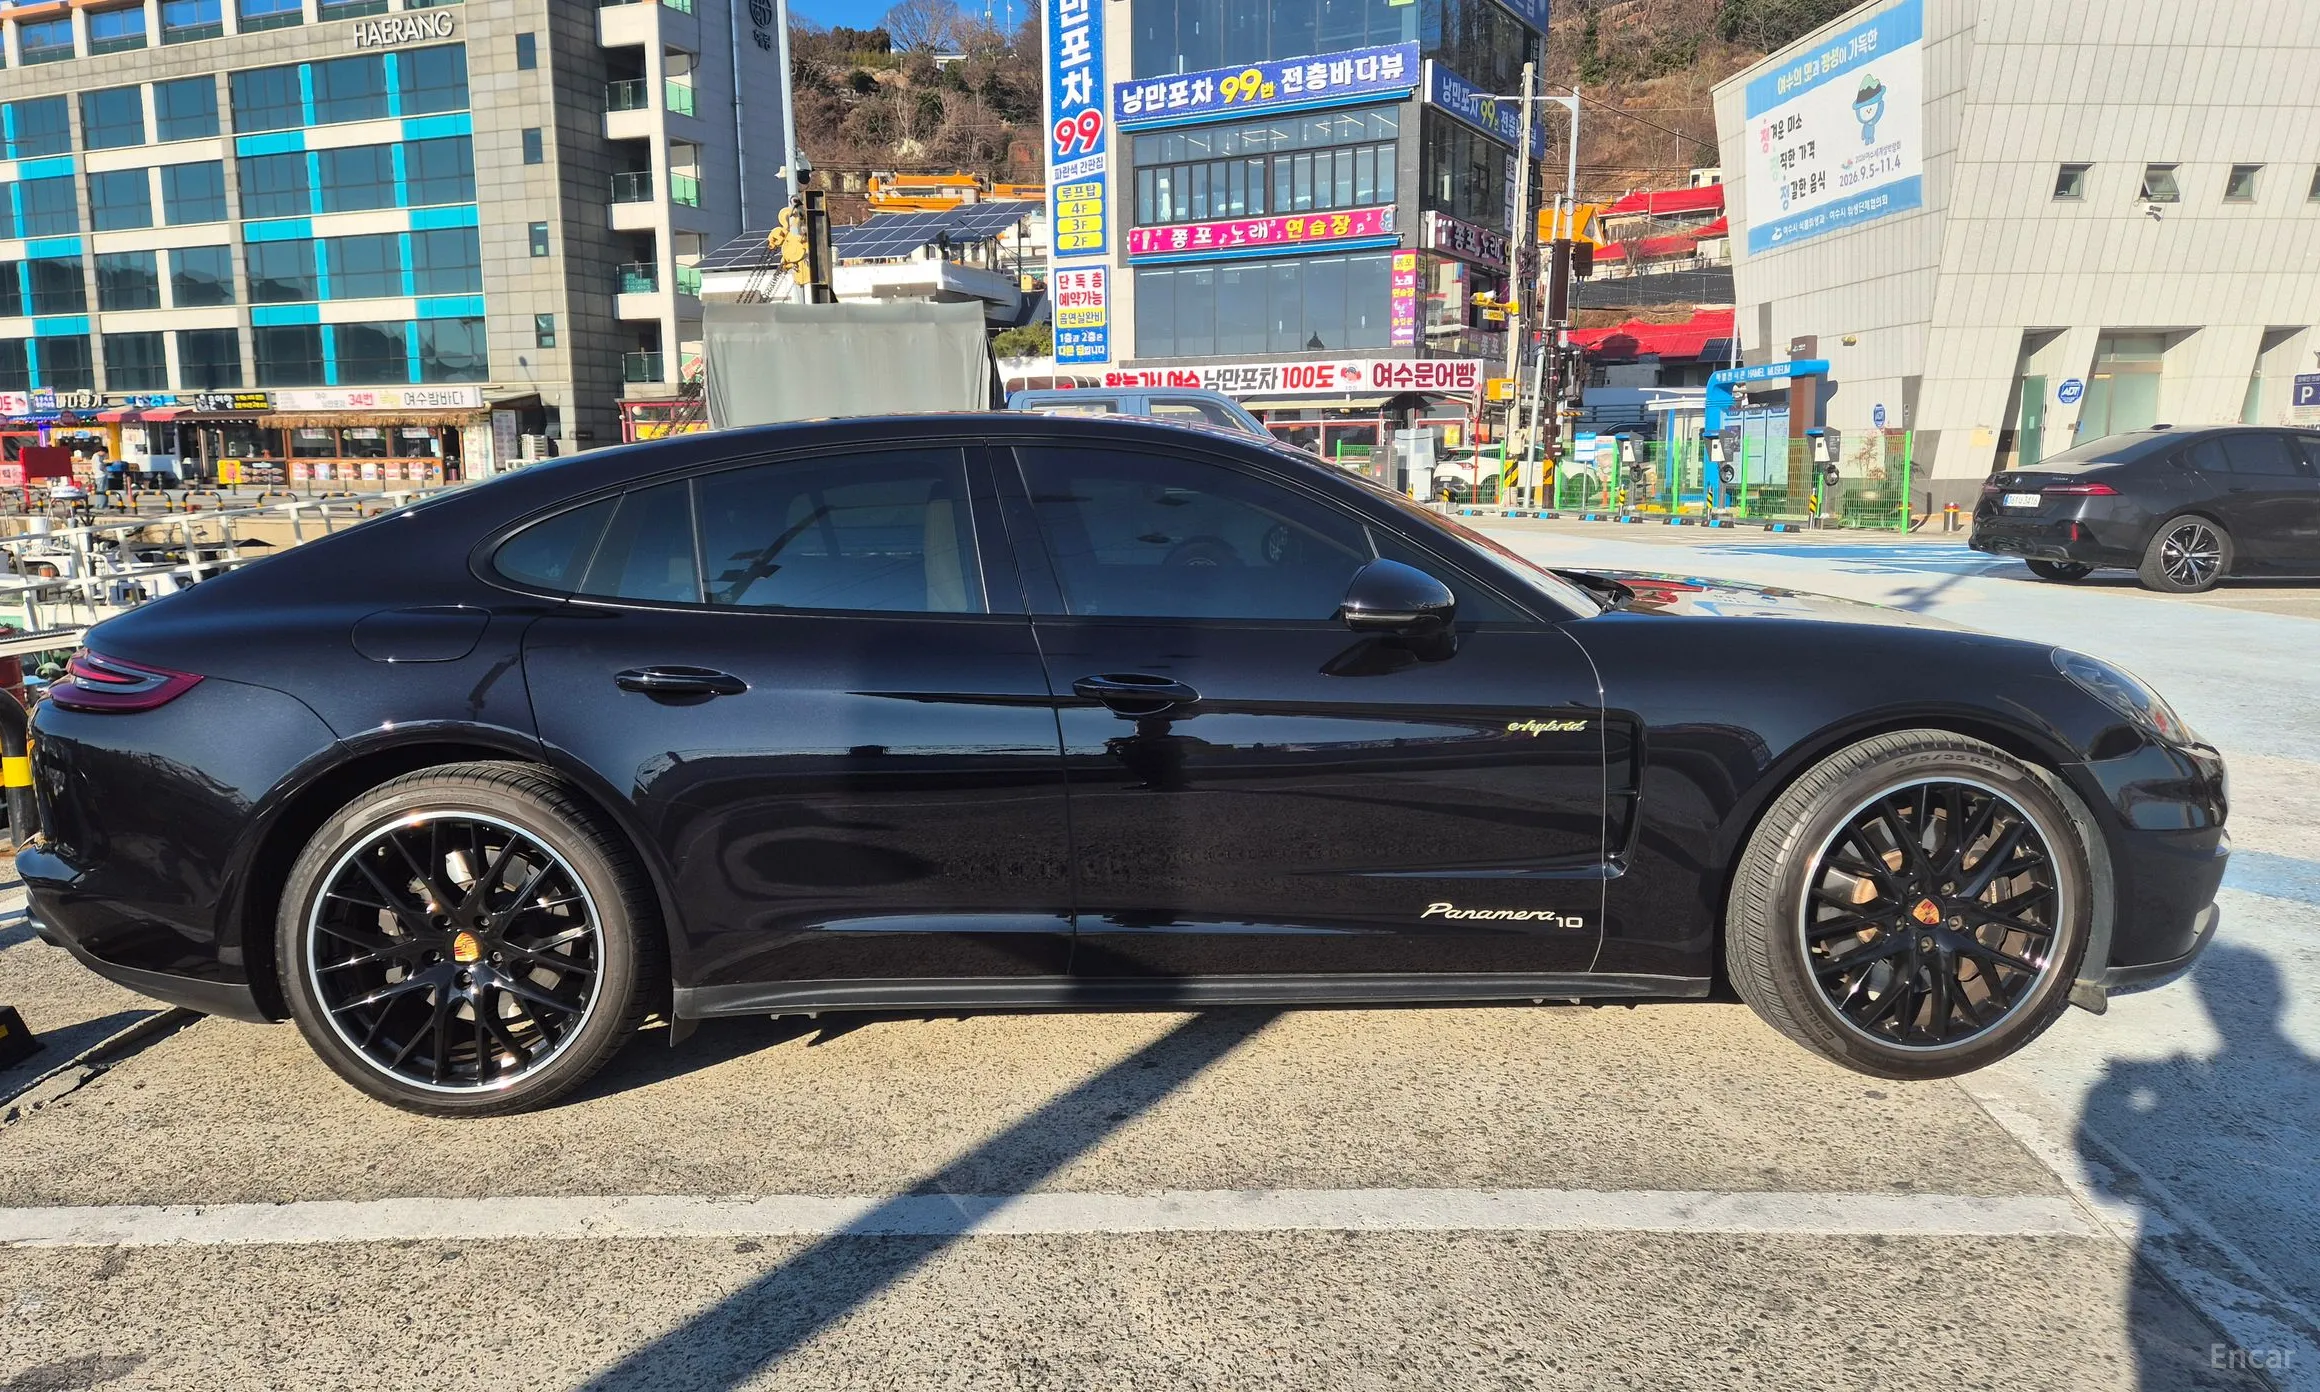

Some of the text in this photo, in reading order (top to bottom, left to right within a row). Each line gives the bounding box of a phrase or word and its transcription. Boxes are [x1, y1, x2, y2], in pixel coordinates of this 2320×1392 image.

[352, 10, 455, 48] HAERANG
[1777, 66, 1802, 95] 여수의
[1848, 27, 1878, 60] 가득한
[1122, 52, 1405, 114] 낭만포차 99번 전층바다뷰
[1053, 108, 1103, 156] 99
[1787, 113, 1802, 133] 미소
[1798, 140, 1815, 160] 가격
[1054, 156, 1104, 181] 파란색 간판집
[1061, 184, 1096, 198] 루프탑
[1810, 170, 1826, 194] 음식
[1071, 203, 1088, 214] 4F
[1071, 219, 1088, 231] 3F
[1230, 221, 1269, 244] 노래
[1285, 215, 1352, 240] 연습장
[1072, 236, 1088, 247] 2F
[1059, 291, 1103, 307] 예약가능
[1060, 311, 1103, 325] 흡연실완비
[1204, 367, 1278, 392] 낭만포차
[1282, 365, 1335, 389] 100도
[1373, 362, 1477, 389] 여수문어빵
[1767, 363, 1791, 376] MUSEUM
[348, 392, 374, 406] 34번
[404, 391, 464, 406] 여수밤바다
[2061, 386, 2080, 396] ADT
[2300, 386, 2314, 404] P
[55, 393, 103, 409] 바다향기
[134, 395, 163, 408] GS25
[1420, 902, 1556, 921] Panamera
